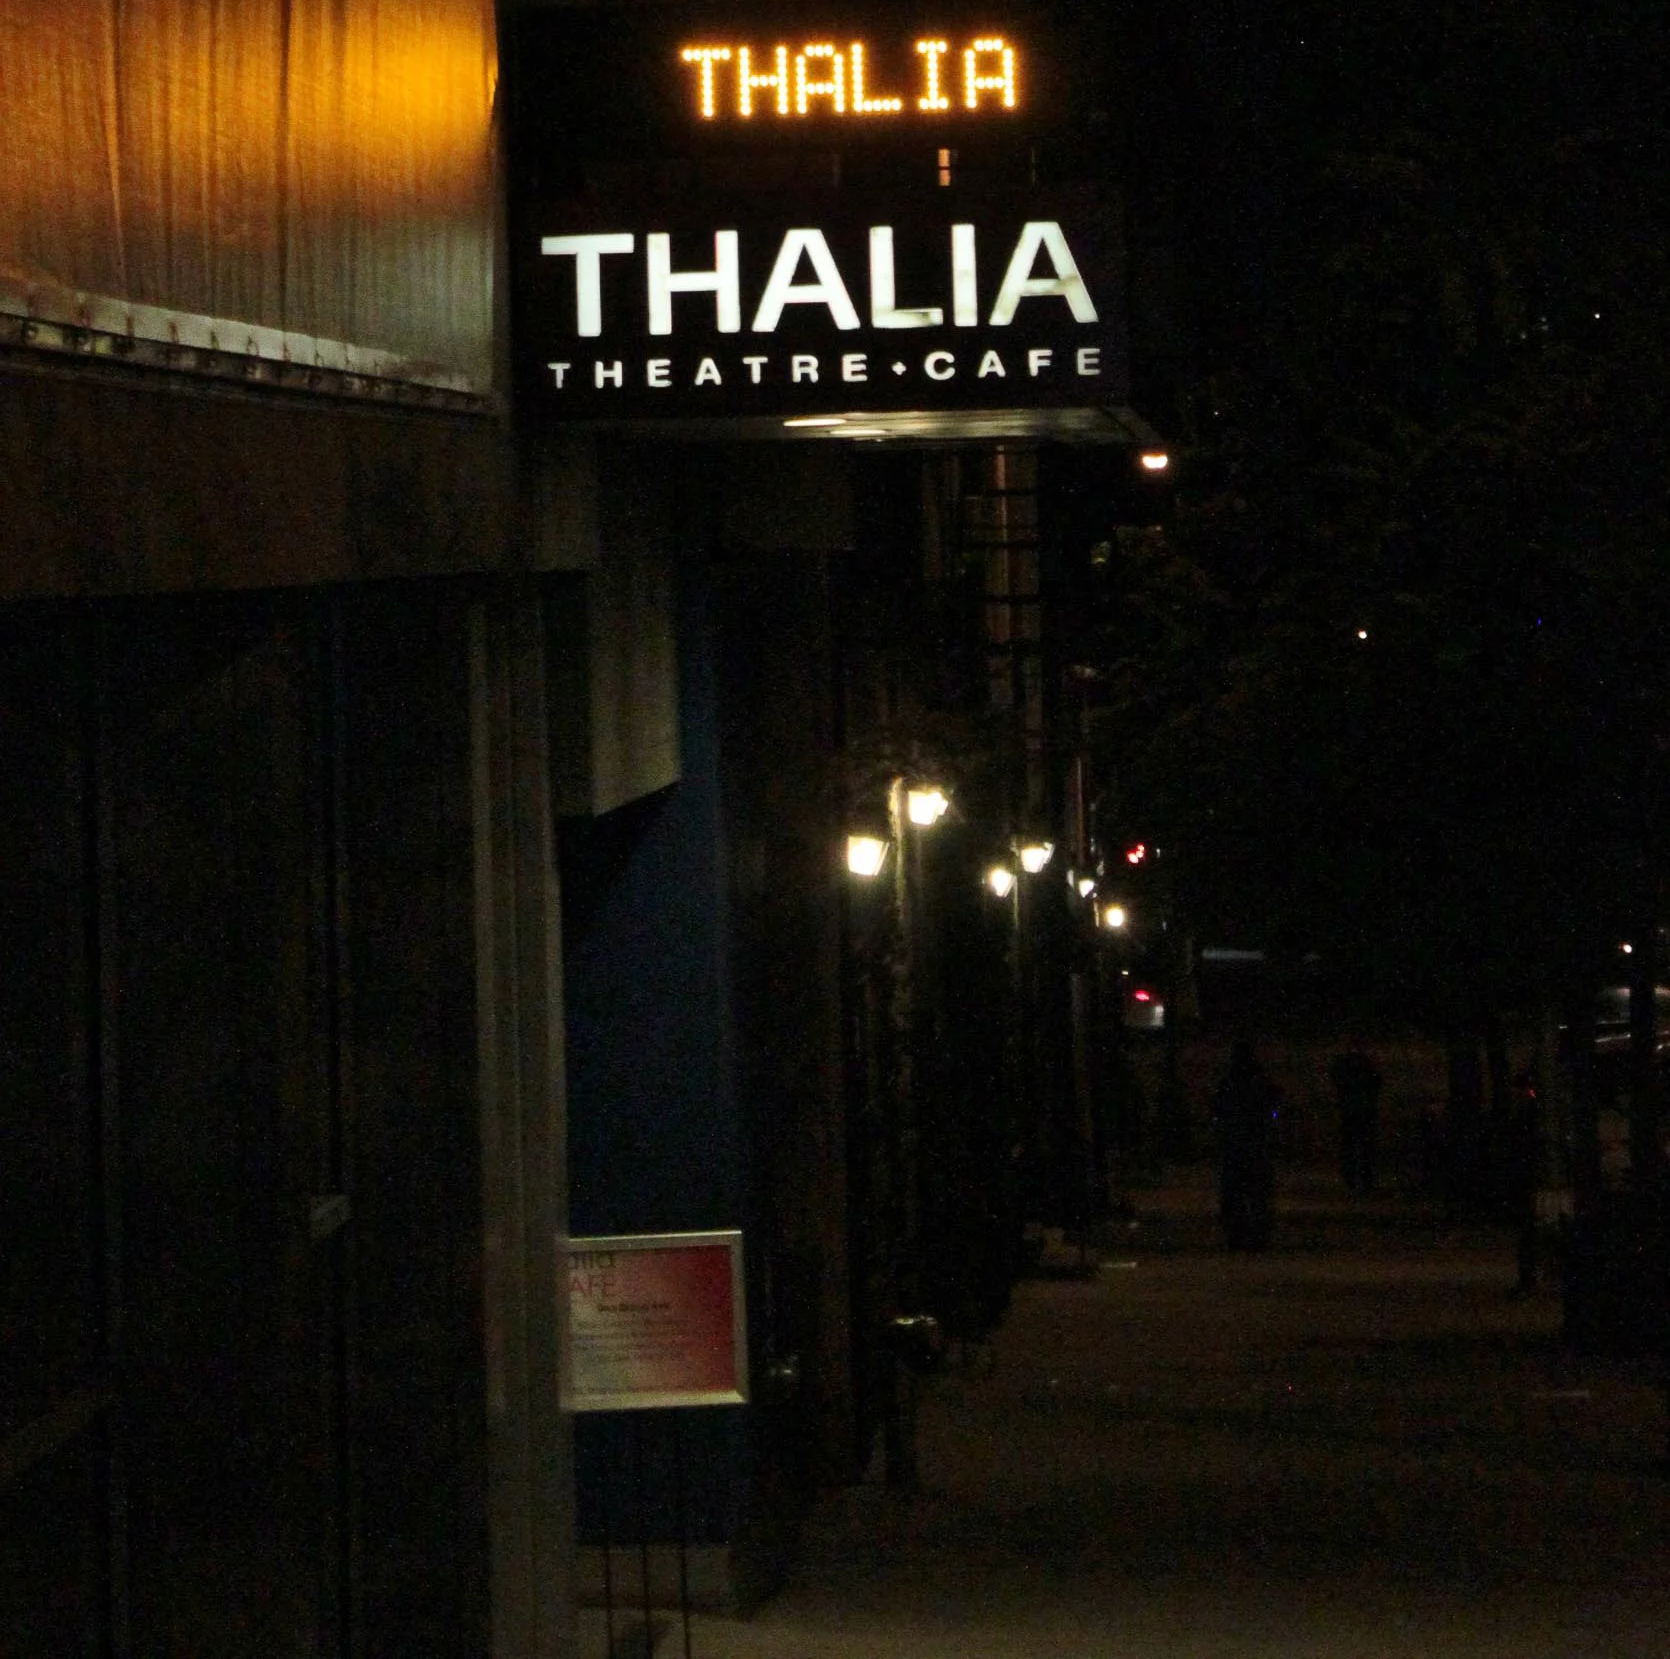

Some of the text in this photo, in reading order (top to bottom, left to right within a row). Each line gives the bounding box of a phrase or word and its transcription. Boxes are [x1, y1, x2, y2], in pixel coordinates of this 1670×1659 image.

[680, 36, 1018, 119] THALIA
[541, 221, 1099, 337] THALIA
[546, 347, 1101, 389] THEATRE CAFE
